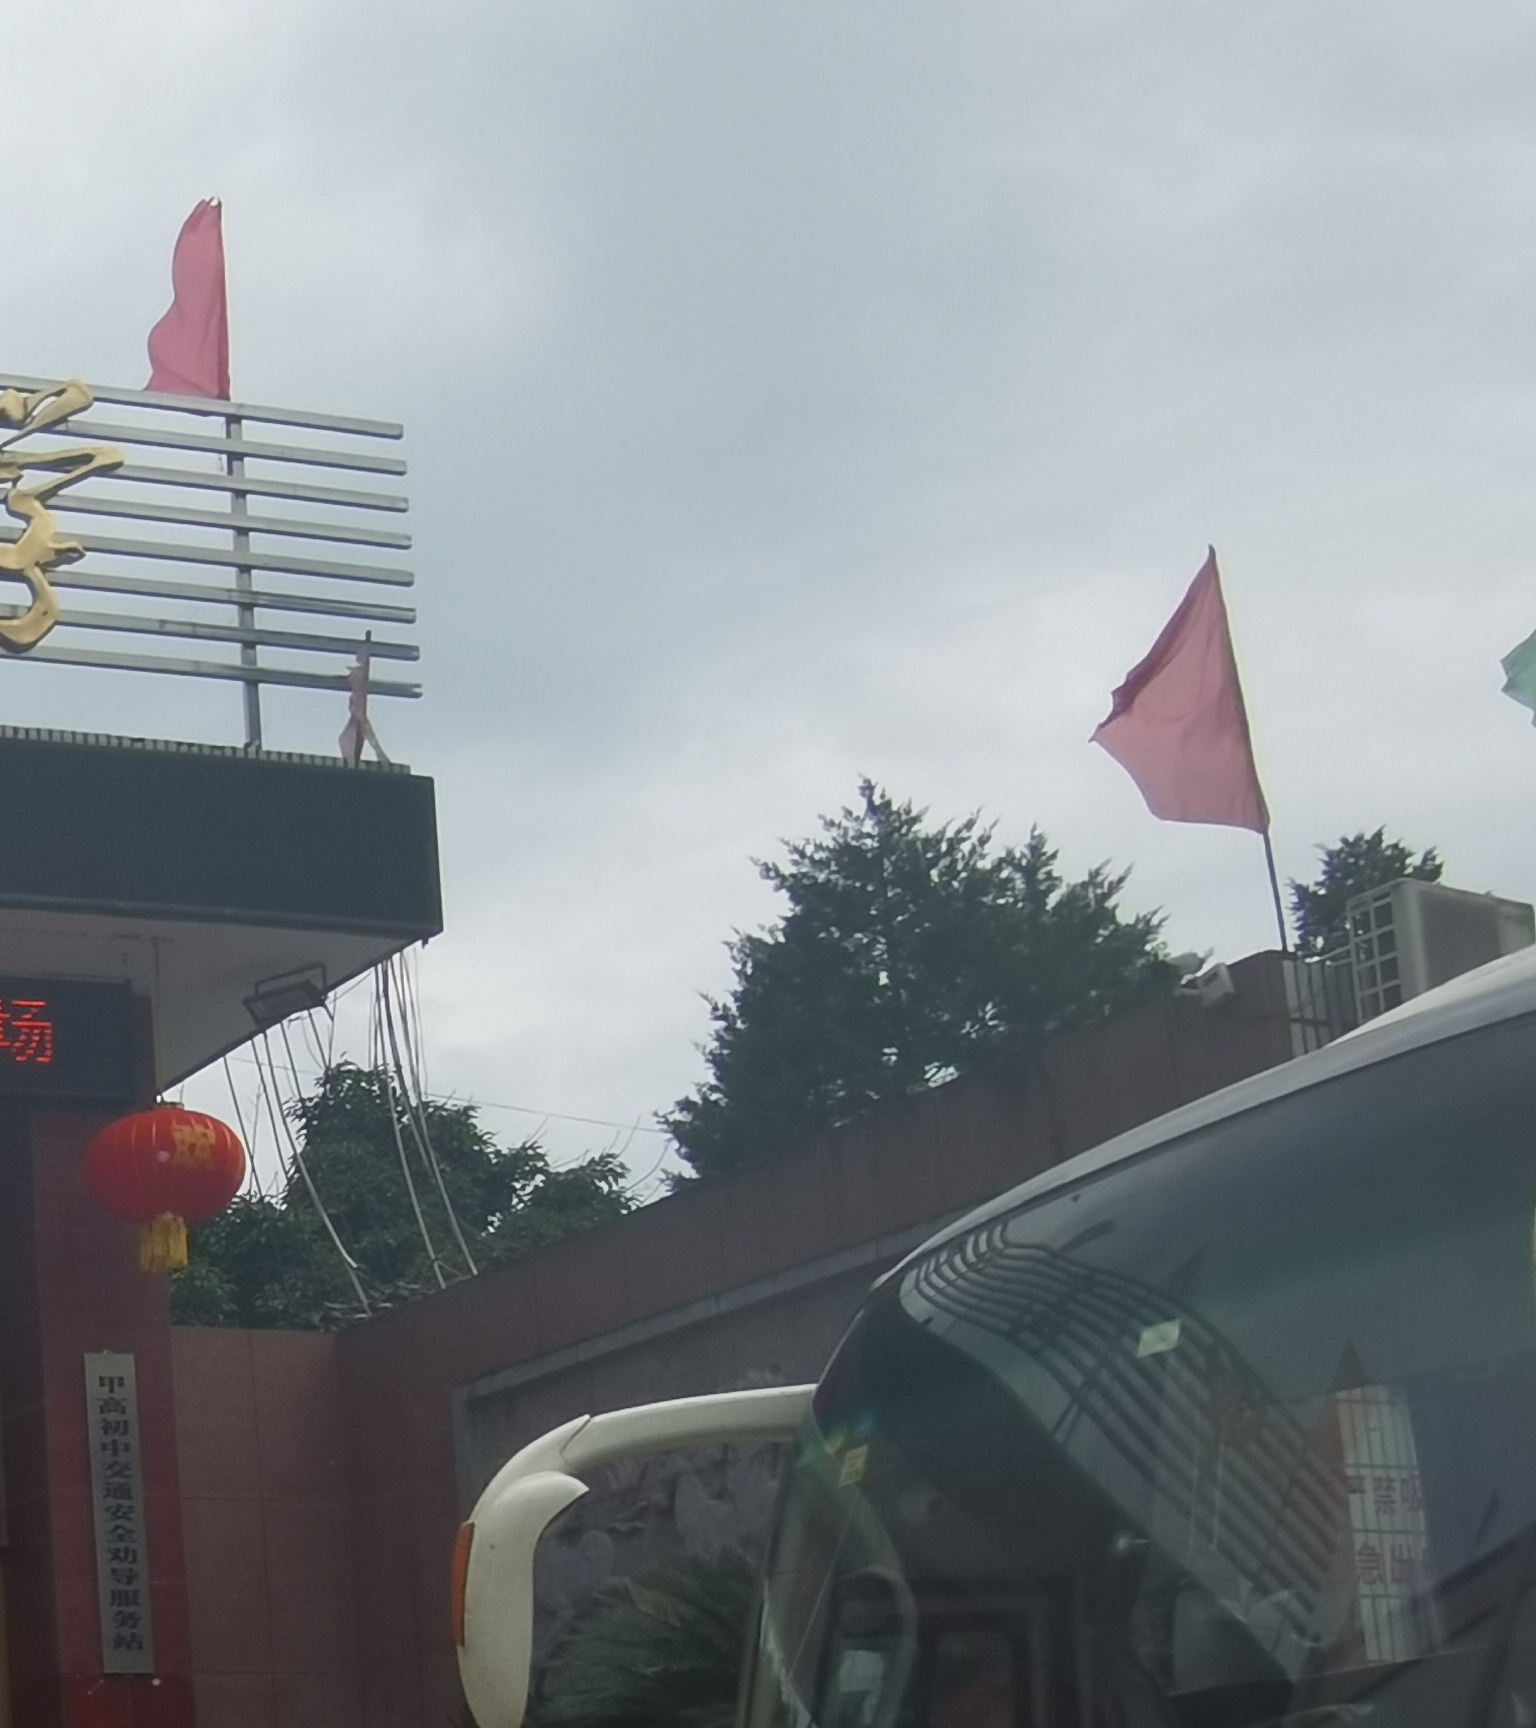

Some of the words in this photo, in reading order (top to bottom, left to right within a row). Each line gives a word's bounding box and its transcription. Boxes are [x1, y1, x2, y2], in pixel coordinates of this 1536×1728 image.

[96, 1374, 144, 1652] 甲高初中交通安全劝导服务站
